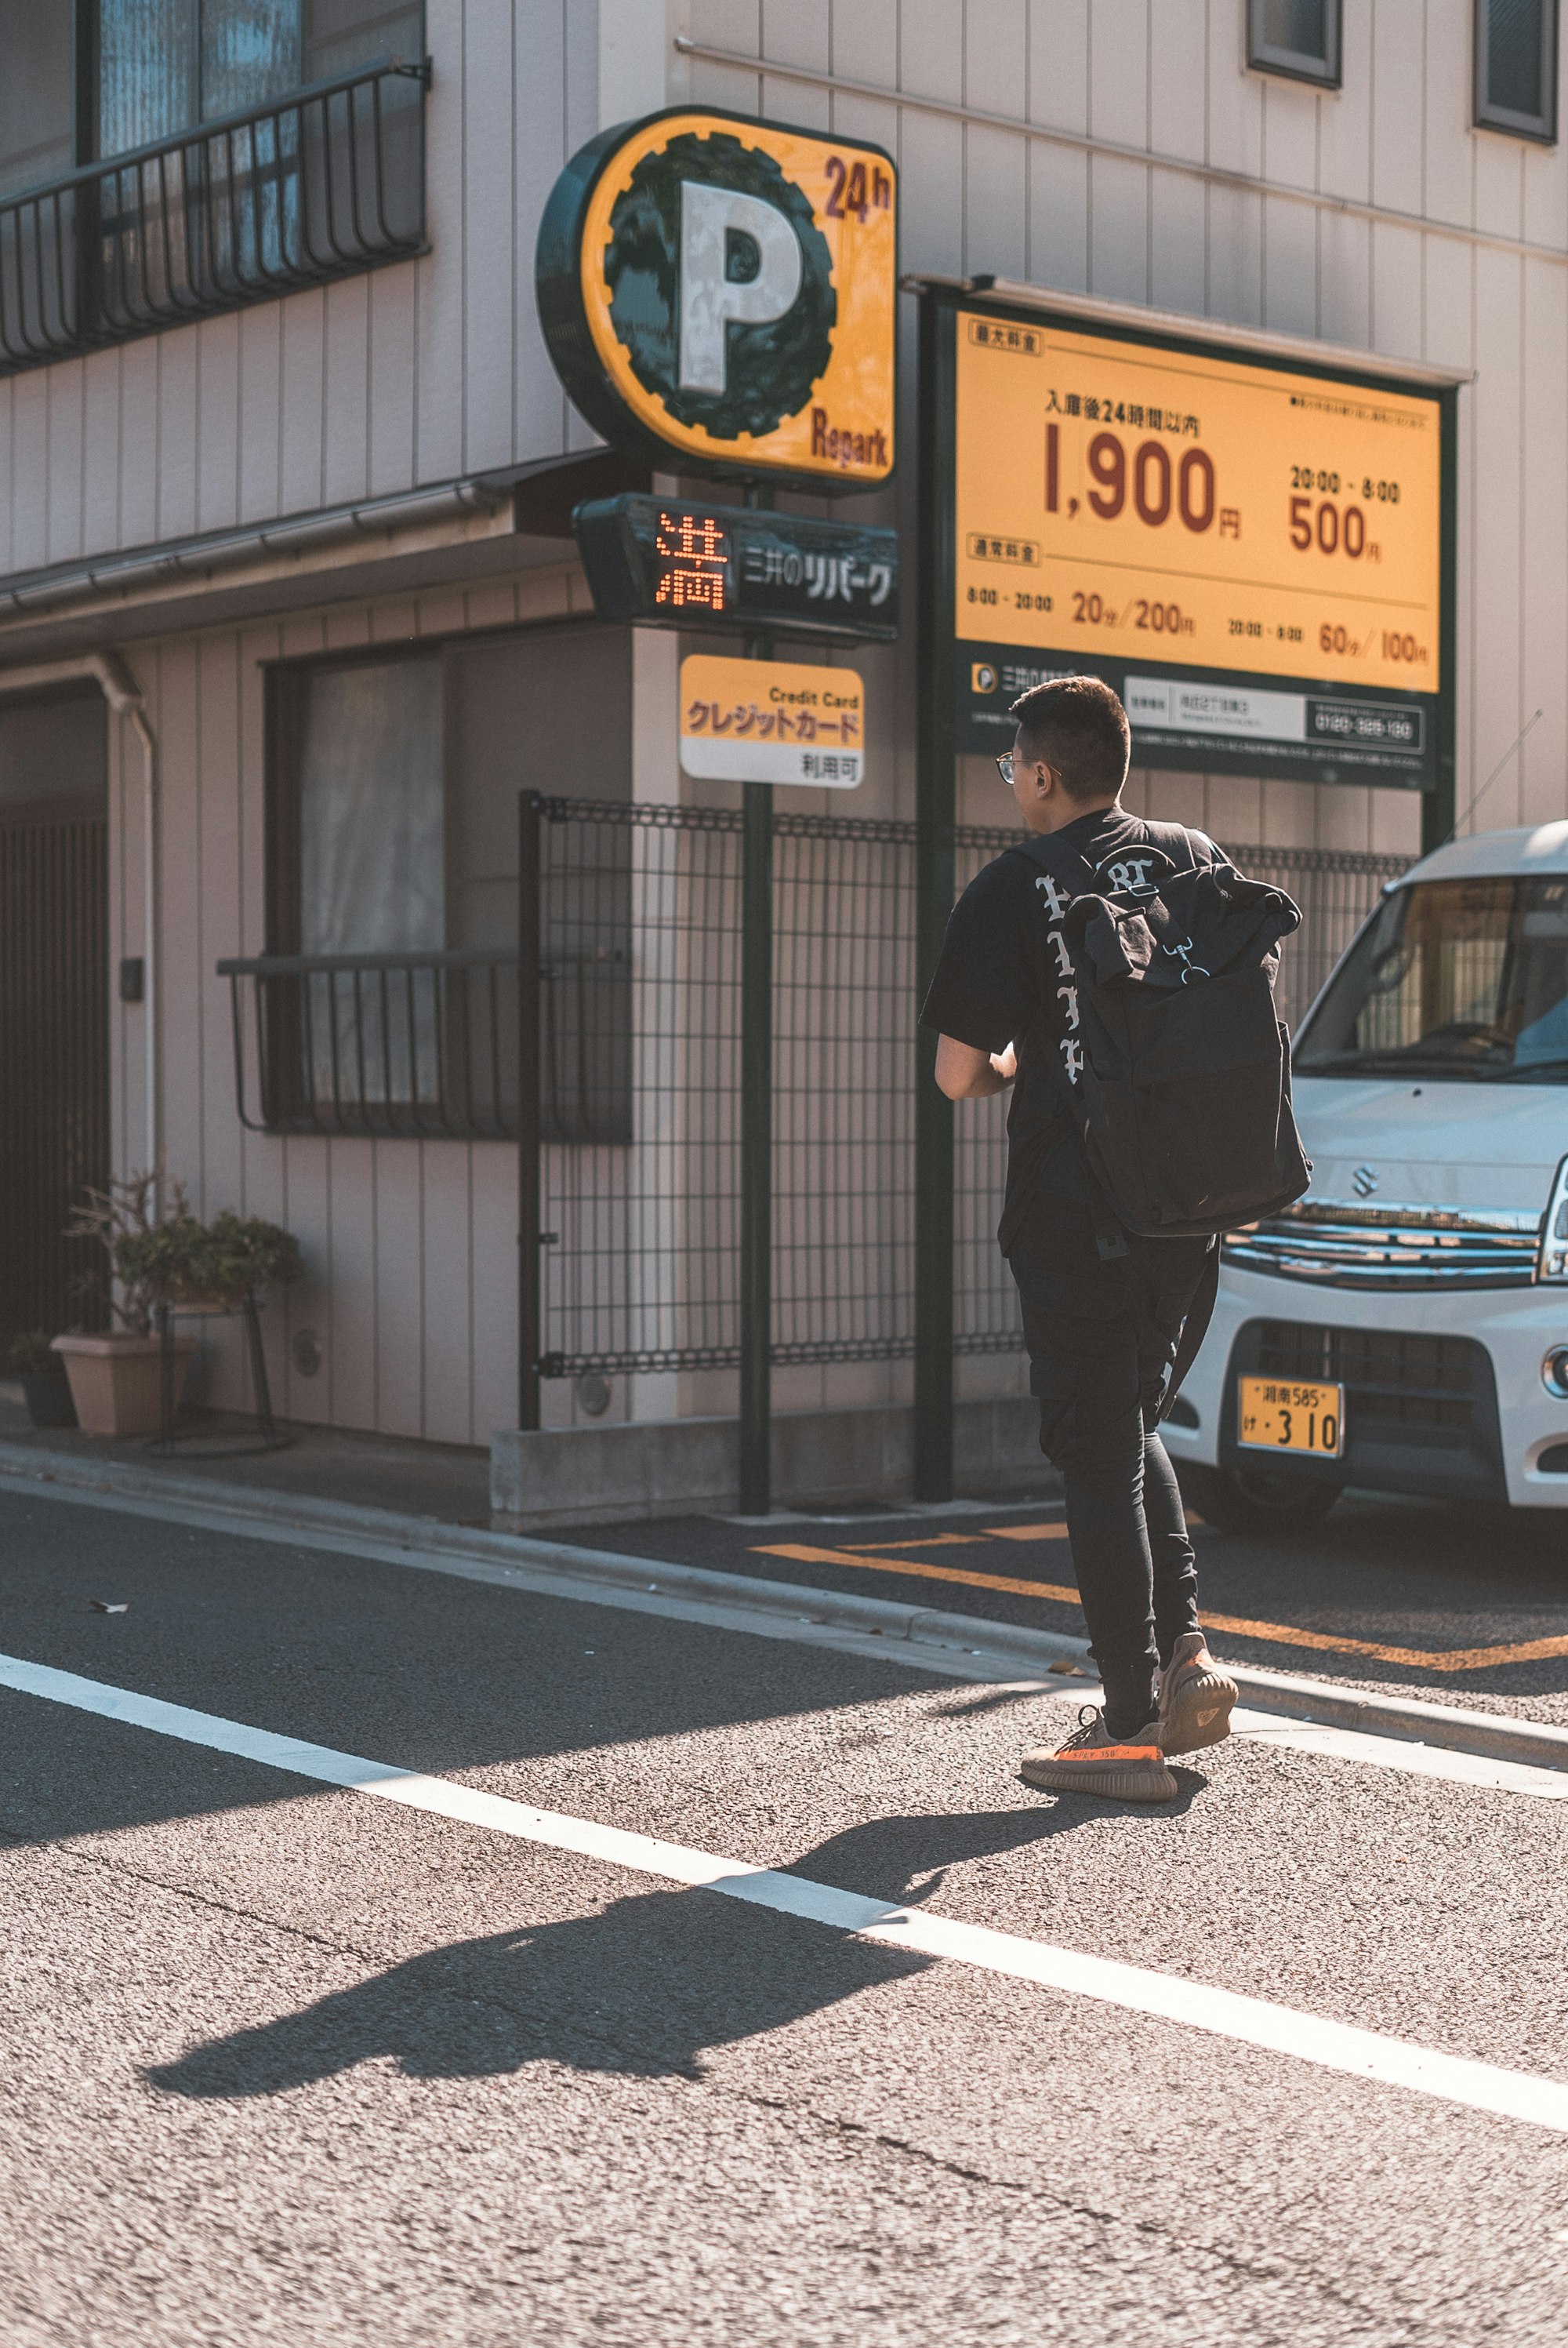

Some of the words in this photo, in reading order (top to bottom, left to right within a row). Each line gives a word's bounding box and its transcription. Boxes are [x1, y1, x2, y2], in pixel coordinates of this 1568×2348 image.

[826, 156, 891, 224] 24h
[679, 180, 802, 396] P
[811, 407, 887, 469] Repark
[1045, 389, 1201, 438] 入庫後24時間以内
[656, 513, 728, 610] 満
[746, 546, 892, 607] 三井のリパーク
[688, 700, 859, 744] クレジットカード
[769, 687, 818, 707] Credit
[823, 692, 859, 710] Card
[801, 752, 859, 783] 利用可
